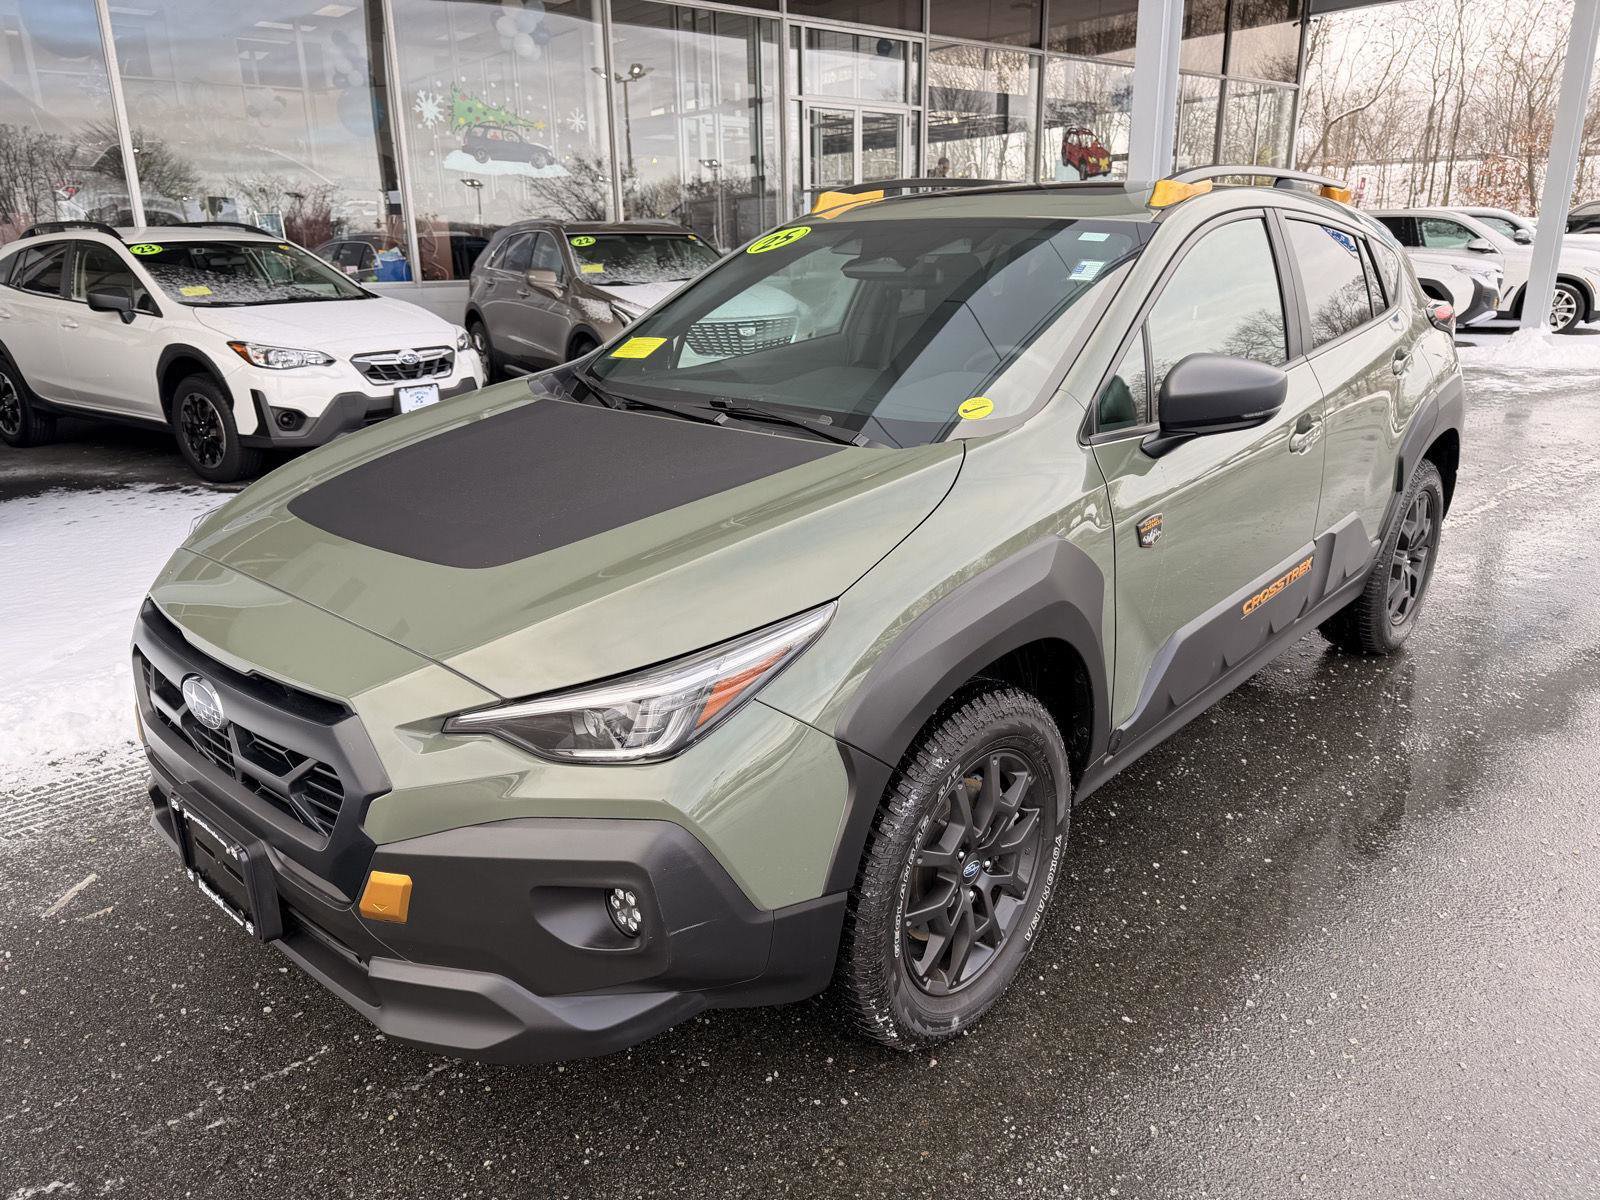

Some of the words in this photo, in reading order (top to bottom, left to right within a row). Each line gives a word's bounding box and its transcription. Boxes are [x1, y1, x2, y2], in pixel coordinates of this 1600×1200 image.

[136, 244, 156, 254] 23
[575, 237, 591, 246] 22
[754, 229, 802, 251] 25
[1242, 556, 1314, 615] CROSSTREK
[894, 815, 930, 958] GEOLANDAR
[1024, 833, 1063, 943] YOKOHAMA
